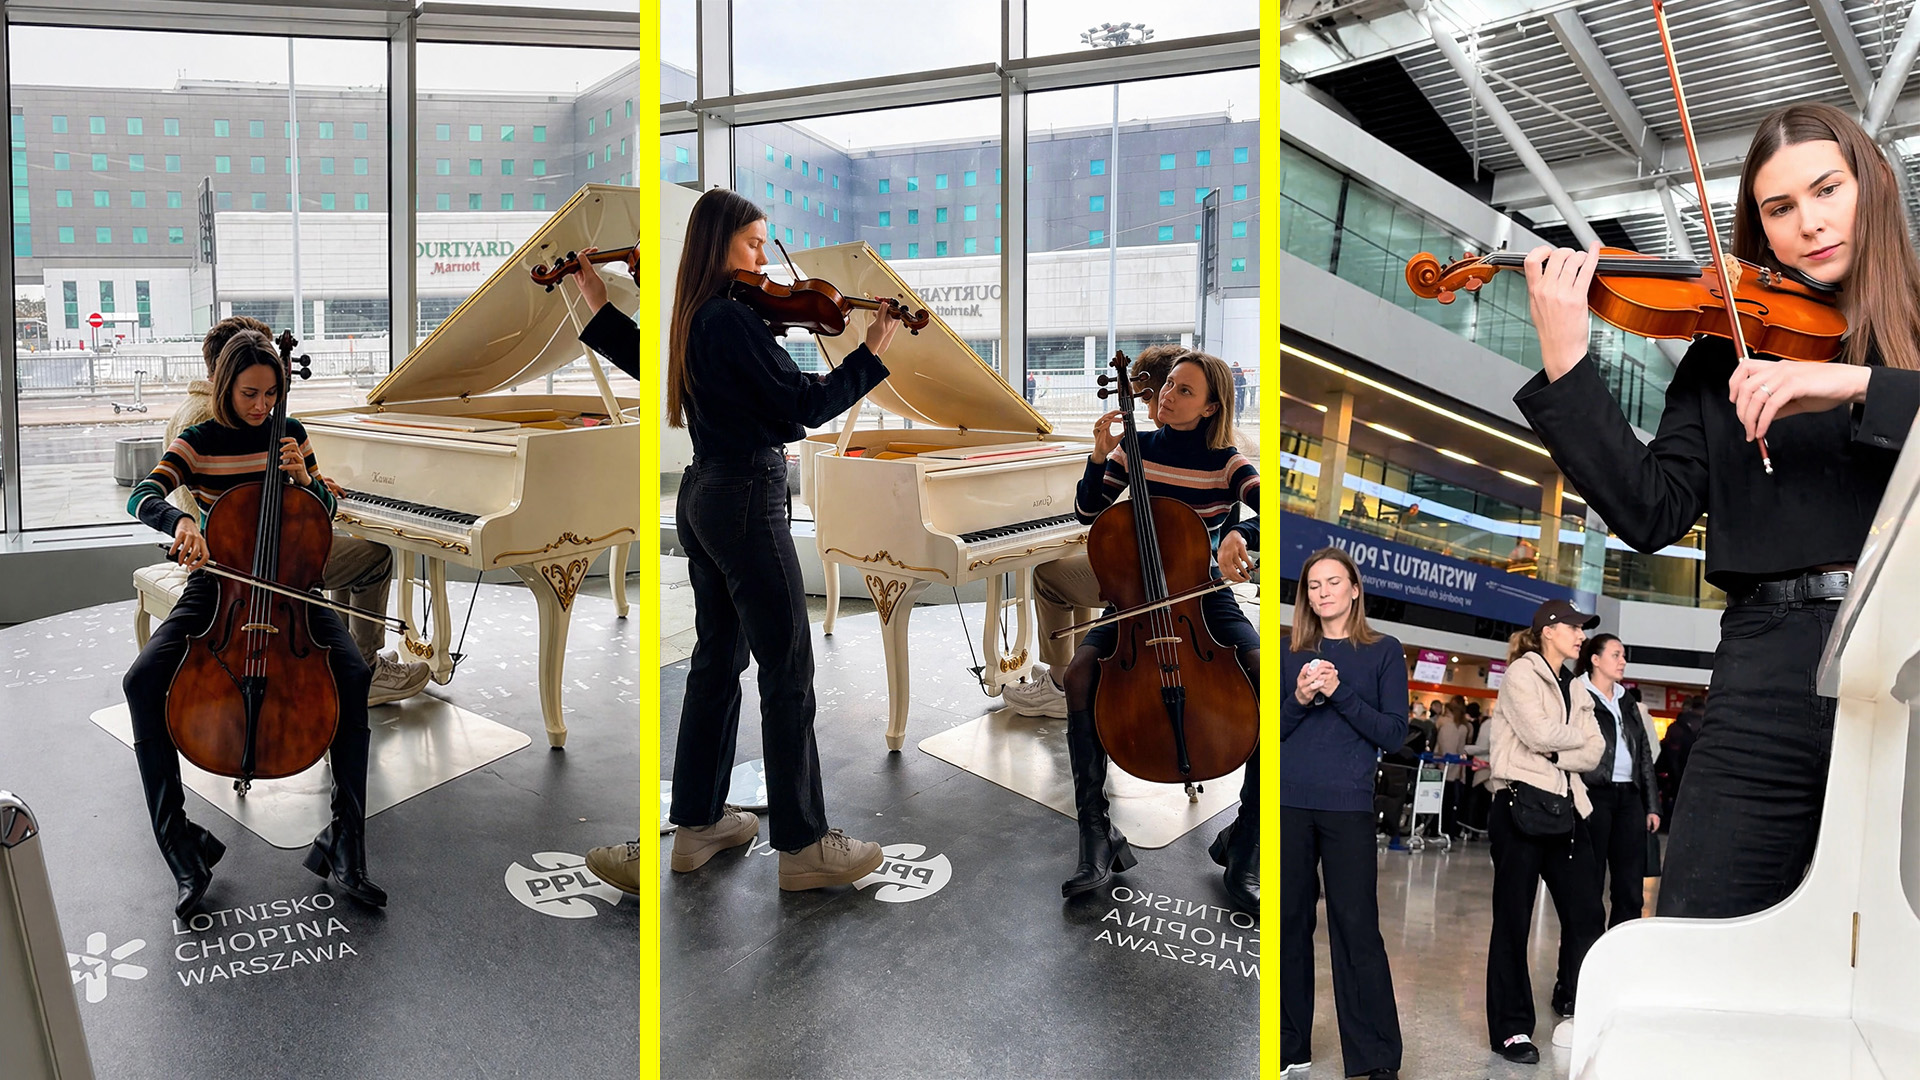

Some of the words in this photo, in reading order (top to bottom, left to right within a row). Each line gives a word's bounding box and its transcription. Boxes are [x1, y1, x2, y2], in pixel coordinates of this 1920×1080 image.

[430, 261, 481, 275] Marriott
[525, 871, 602, 897] PPL
[172, 893, 335, 936] LOTNISKO
[174, 917, 350, 962] CHOPINA
[177, 942, 358, 987] WARSZAWA
